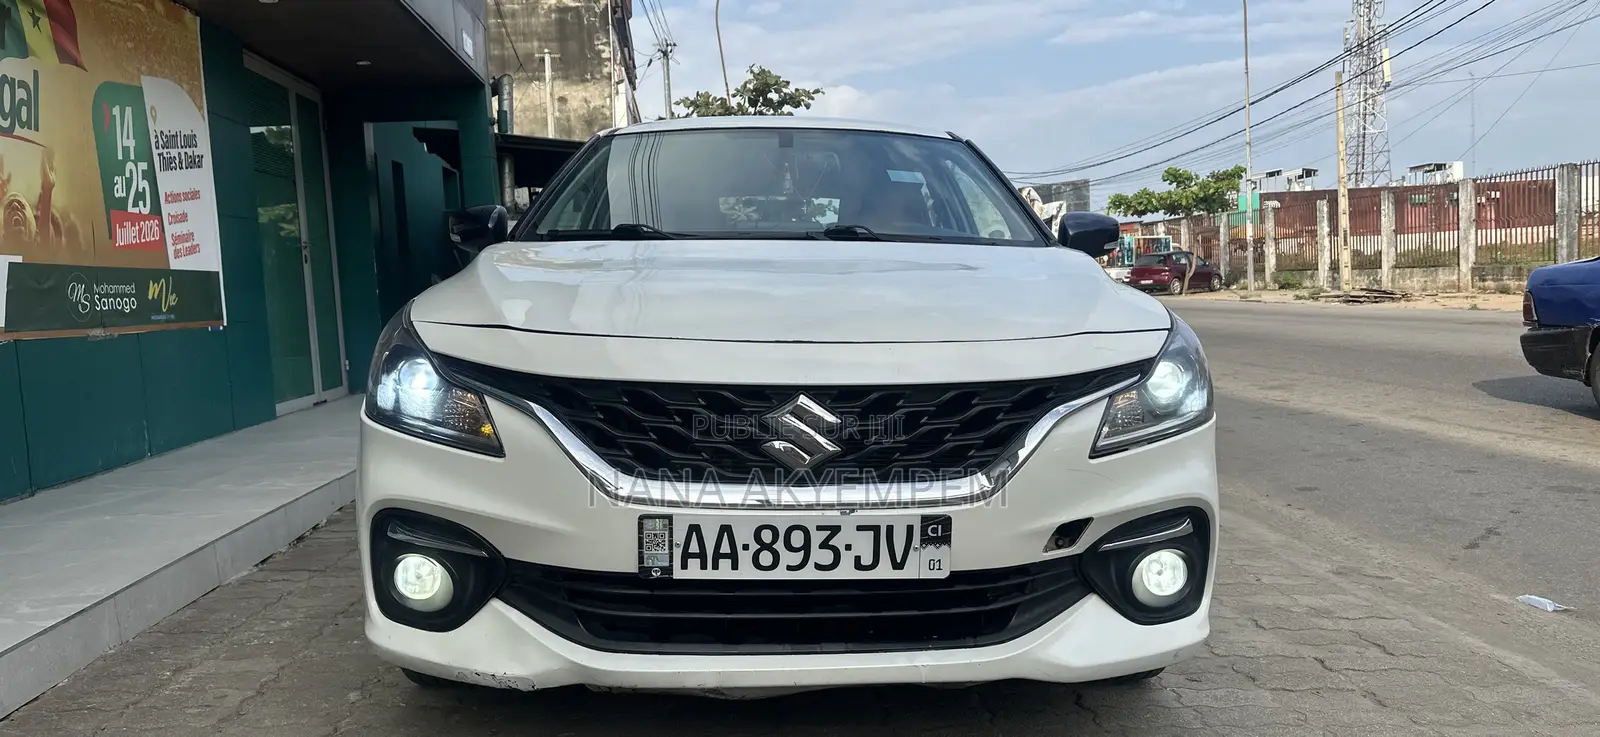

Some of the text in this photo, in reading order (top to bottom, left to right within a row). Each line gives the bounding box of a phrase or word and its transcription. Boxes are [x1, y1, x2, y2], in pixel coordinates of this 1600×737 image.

[112, 104, 136, 160] 14
[154, 129, 198, 150] à Saint Louis
[157, 150, 204, 172] Thiès & Dakar
[114, 161, 151, 215] au 25
[164, 188, 201, 204] Actions sociales
[167, 211, 188, 226] Croisade
[115, 219, 160, 247] Juillet 2026
[171, 230, 195, 246] Séminaire
[173, 243, 201, 259] des Leaders
[93, 282, 136, 294] Mohammed
[94, 294, 137, 313] Sanogo
[927, 524, 943, 537] CI
[928, 559, 943, 571] 01
